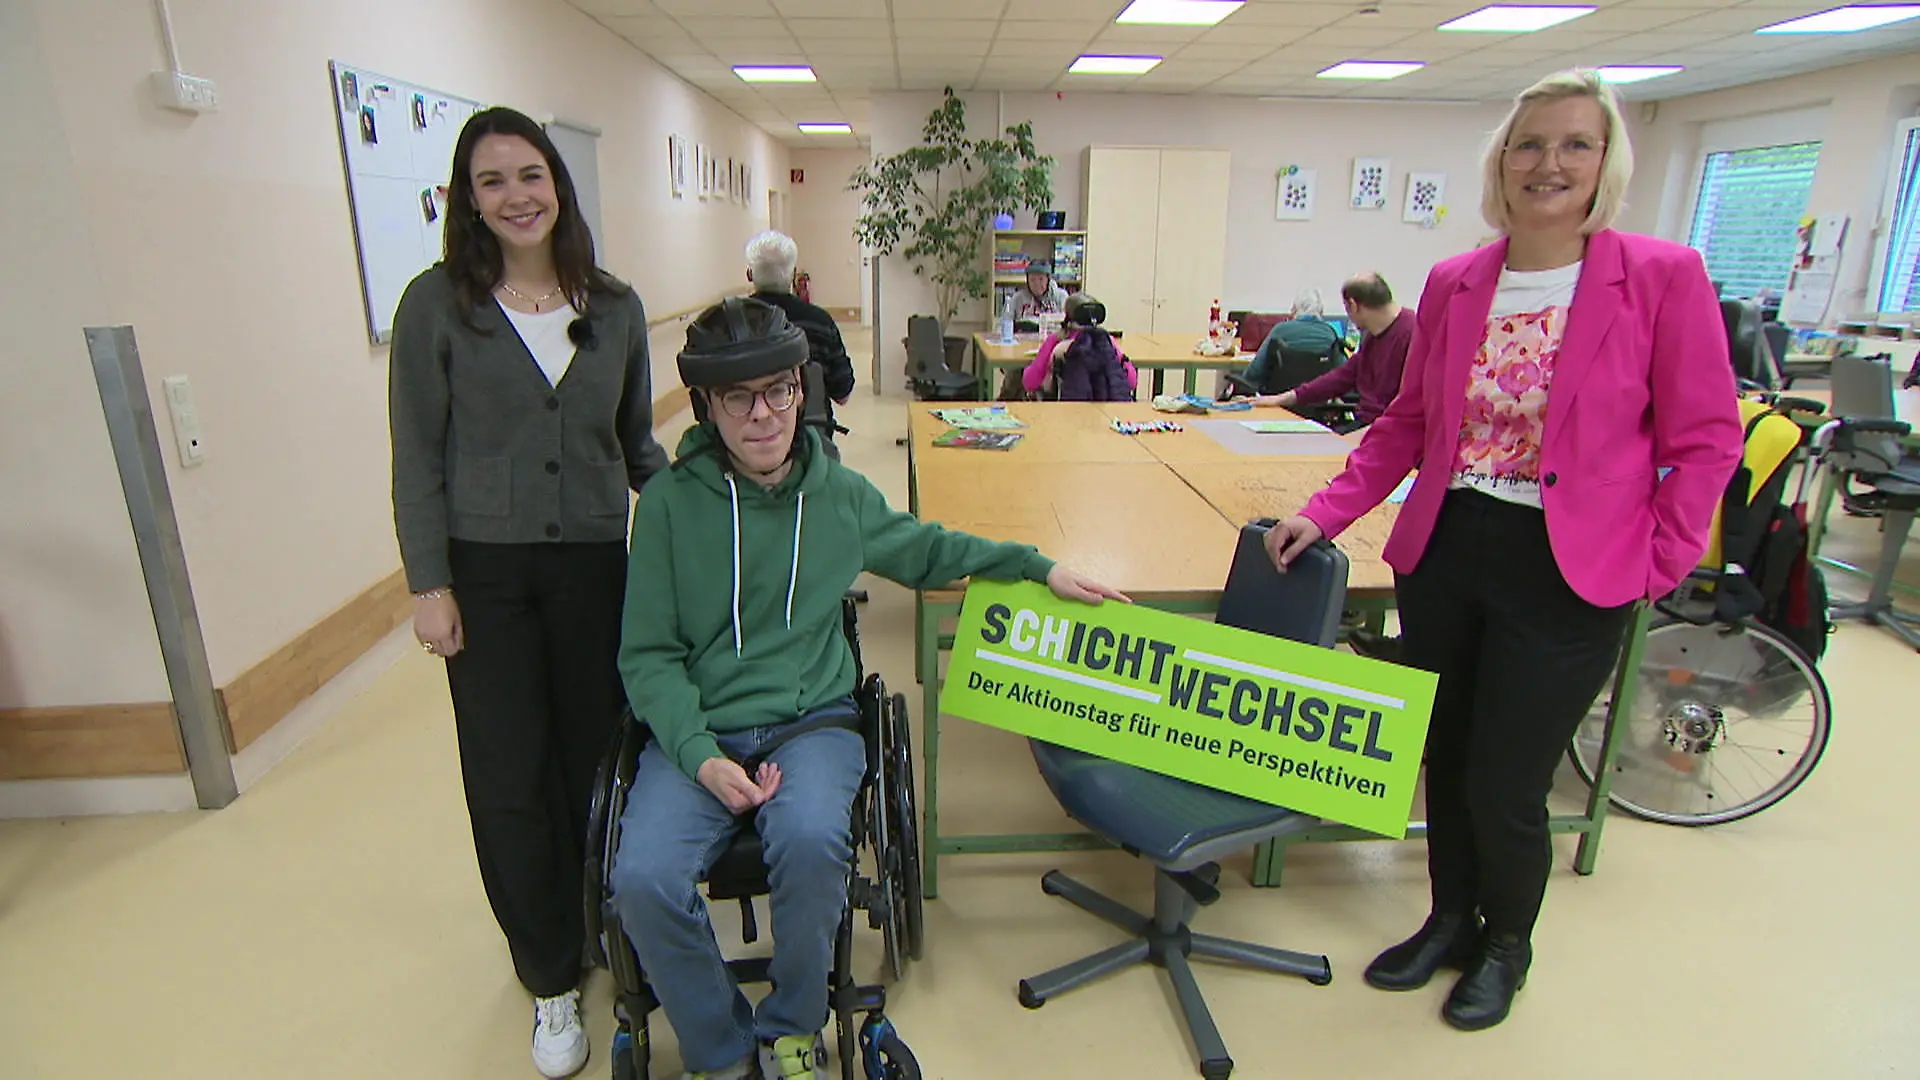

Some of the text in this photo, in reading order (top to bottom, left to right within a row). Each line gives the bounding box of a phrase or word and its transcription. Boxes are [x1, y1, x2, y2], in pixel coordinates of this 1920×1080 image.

[980, 603, 1176, 686] SCHICHT
[967, 671, 1387, 799] Der Aktionstag für neue Perspektiven
[1169, 663, 1393, 763] WECHSEL
